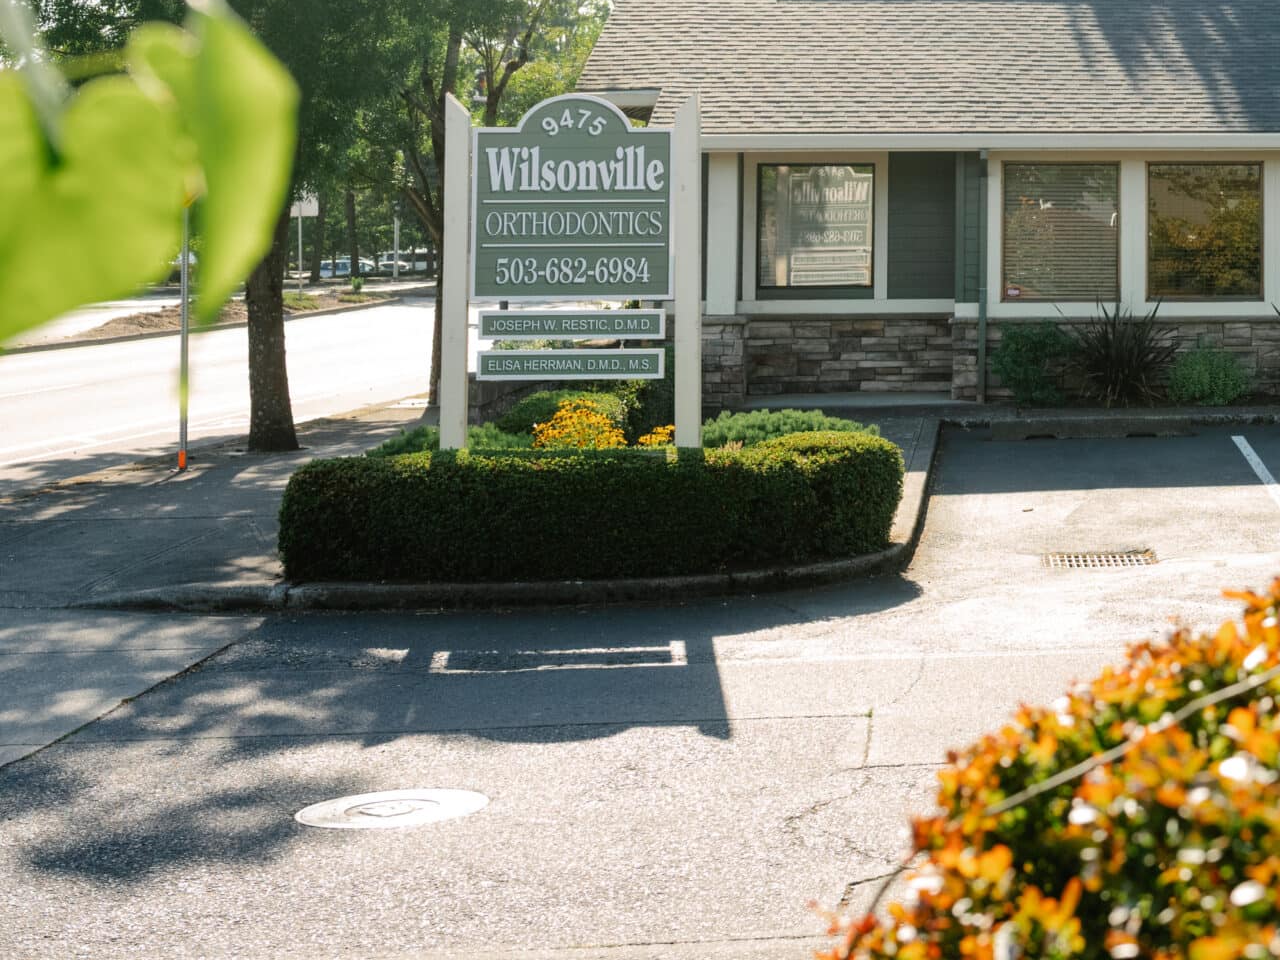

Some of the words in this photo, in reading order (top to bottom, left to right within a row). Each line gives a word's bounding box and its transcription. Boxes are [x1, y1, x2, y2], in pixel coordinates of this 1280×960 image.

[541, 108, 608, 136] 9475
[485, 145, 665, 192] Wilsonville
[485, 211, 663, 236] ORTHODONTICS
[495, 257, 651, 285] 503-682-6984
[489, 319, 540, 331] JOSEPH
[543, 319, 558, 331] W.
[561, 319, 611, 331] RESTIC,
[614, 318, 653, 330] D.M.D.
[488, 360, 521, 371] ELISA
[523, 359, 585, 371] HERRMAN,
[587, 359, 626, 371] D.M.D.,
[629, 359, 652, 370] M.S.
